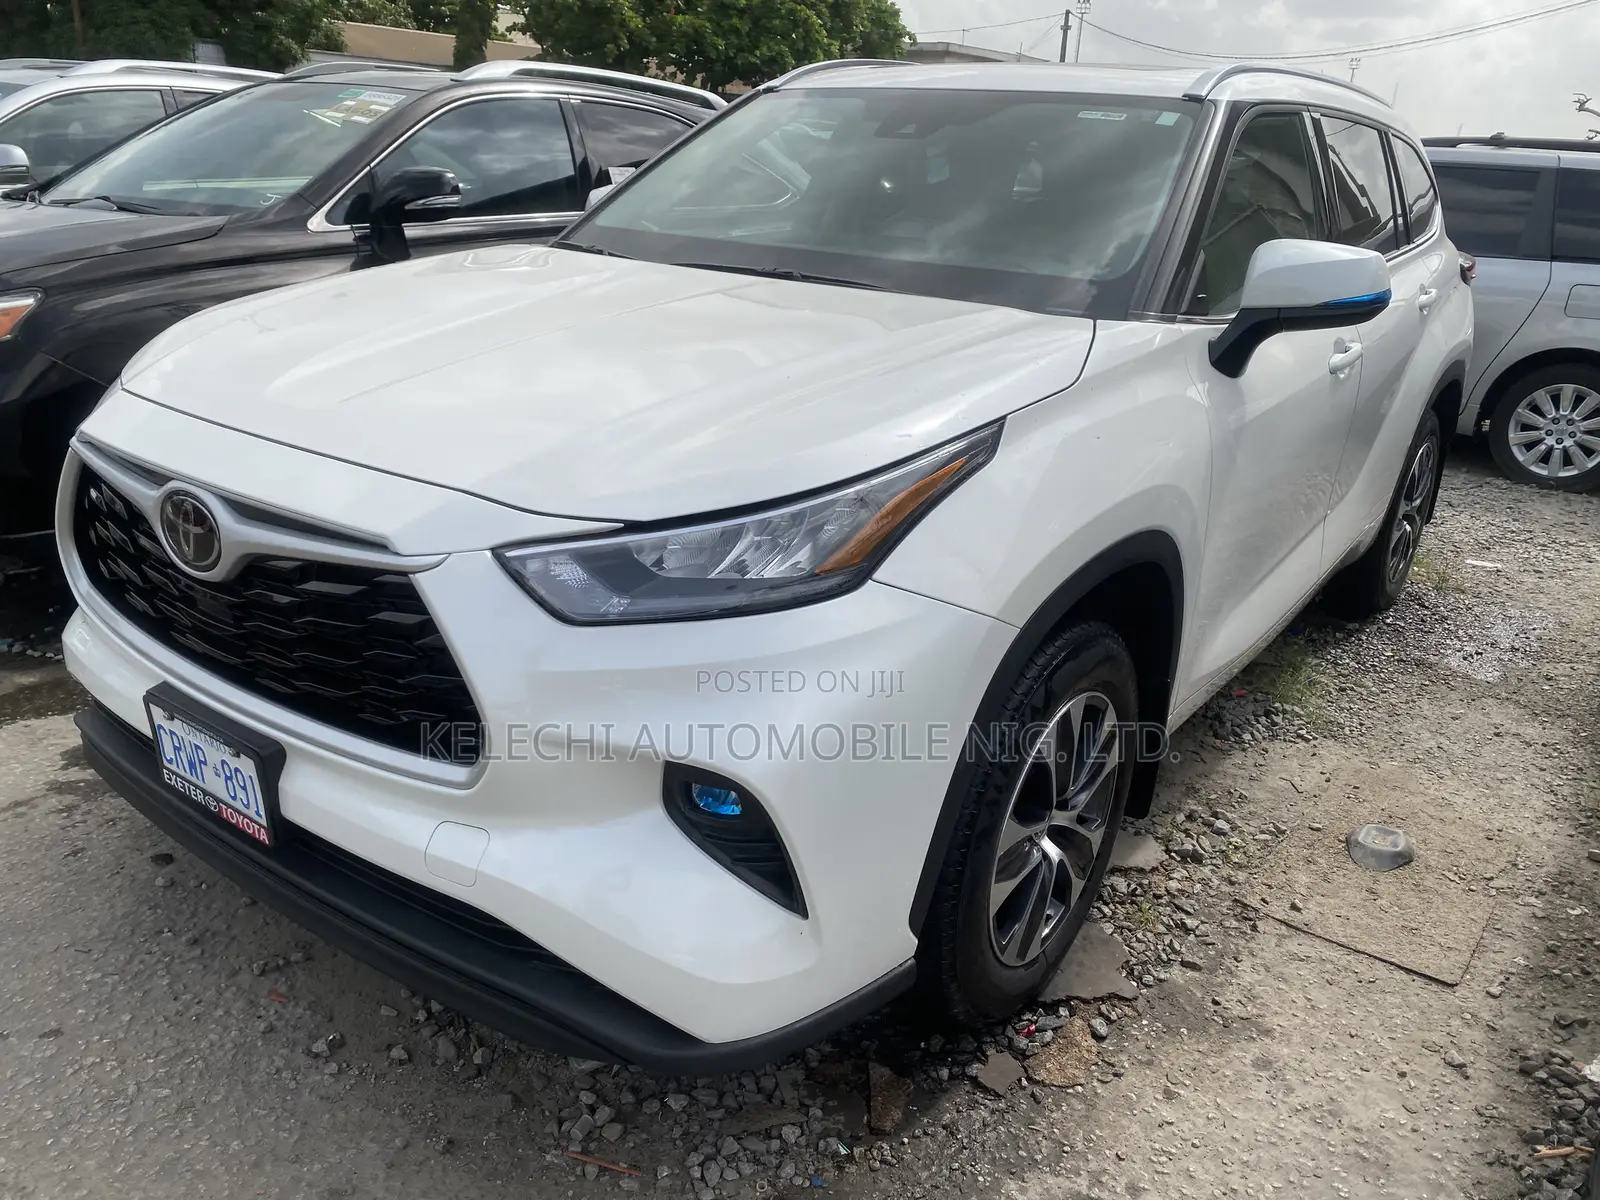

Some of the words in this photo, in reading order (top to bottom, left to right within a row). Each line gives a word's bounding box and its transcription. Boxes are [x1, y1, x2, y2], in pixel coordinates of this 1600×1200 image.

[156, 723, 208, 785] CRWP
[221, 758, 263, 819] 891
[181, 722, 227, 754] ONTARIO
[163, 768, 206, 806] EXETER
[219, 802, 269, 845] TOYOTA
